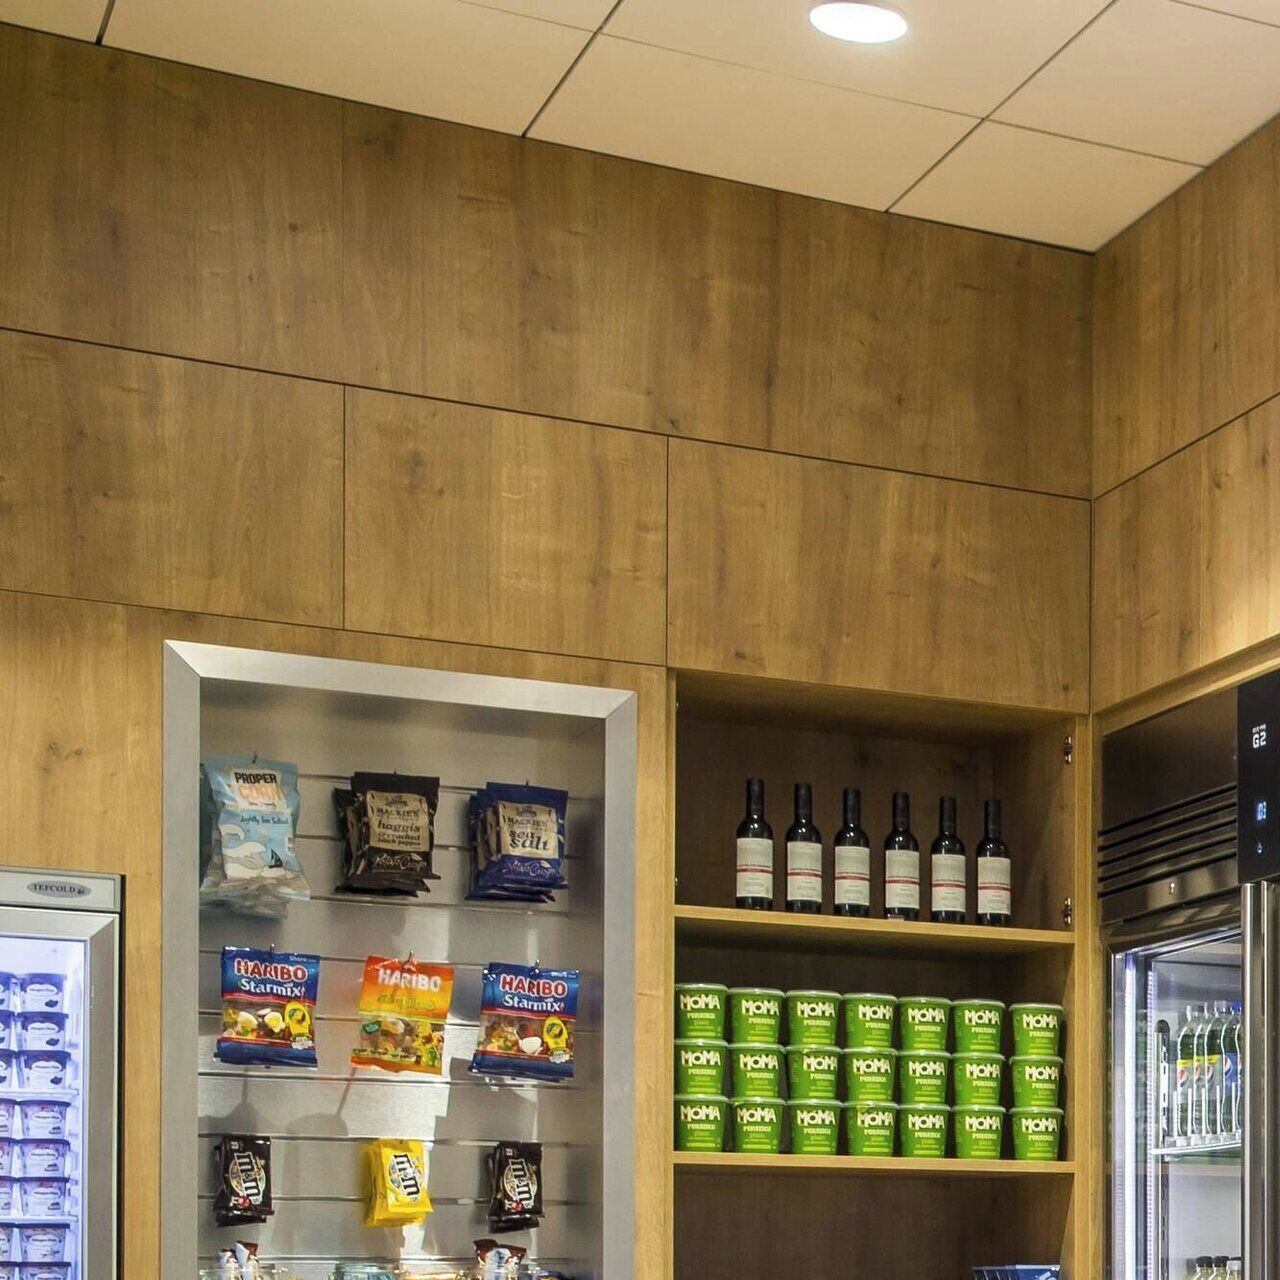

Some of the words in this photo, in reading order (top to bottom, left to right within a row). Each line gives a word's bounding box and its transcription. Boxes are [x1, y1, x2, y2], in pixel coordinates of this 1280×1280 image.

[1253, 731, 1267, 749] G2
[234, 772, 278, 784] PROPER
[509, 830, 535, 840] sea
[509, 837, 549, 851] salt
[33, 883, 76, 893] TEFCOLD
[234, 958, 307, 982] HARIBO
[240, 978, 302, 997] Starmix
[378, 968, 441, 992] HARIBO
[500, 974, 568, 998] HARIBO
[504, 994, 560, 1011] Starmix
[680, 994, 722, 1012] MOMA
[742, 1000, 781, 1018] MOMA
[797, 1002, 837, 1019] MOMA
[859, 1004, 894, 1022] MOMA
[908, 1008, 947, 1025] MOMA
[965, 1010, 1001, 1027] MOMA
[1023, 1014, 1059, 1031] MOMA
[681, 1051, 722, 1068] MOMA
[740, 1054, 780, 1072] MOMA
[803, 1056, 839, 1073] MOMA
[853, 1059, 892, 1076] MOMA
[909, 1061, 947, 1078] MOMA
[966, 1063, 1001, 1081] MOMA
[1025, 1066, 1060, 1083] MOMA
[681, 1106, 722, 1123] MOMA
[738, 1107, 778, 1126] MOMA
[797, 1110, 837, 1128] MOMA
[857, 1112, 895, 1129] MOMA
[908, 1114, 946, 1132] MOMA
[965, 1116, 1002, 1133] MOMA
[1022, 1118, 1059, 1135] MOMA
